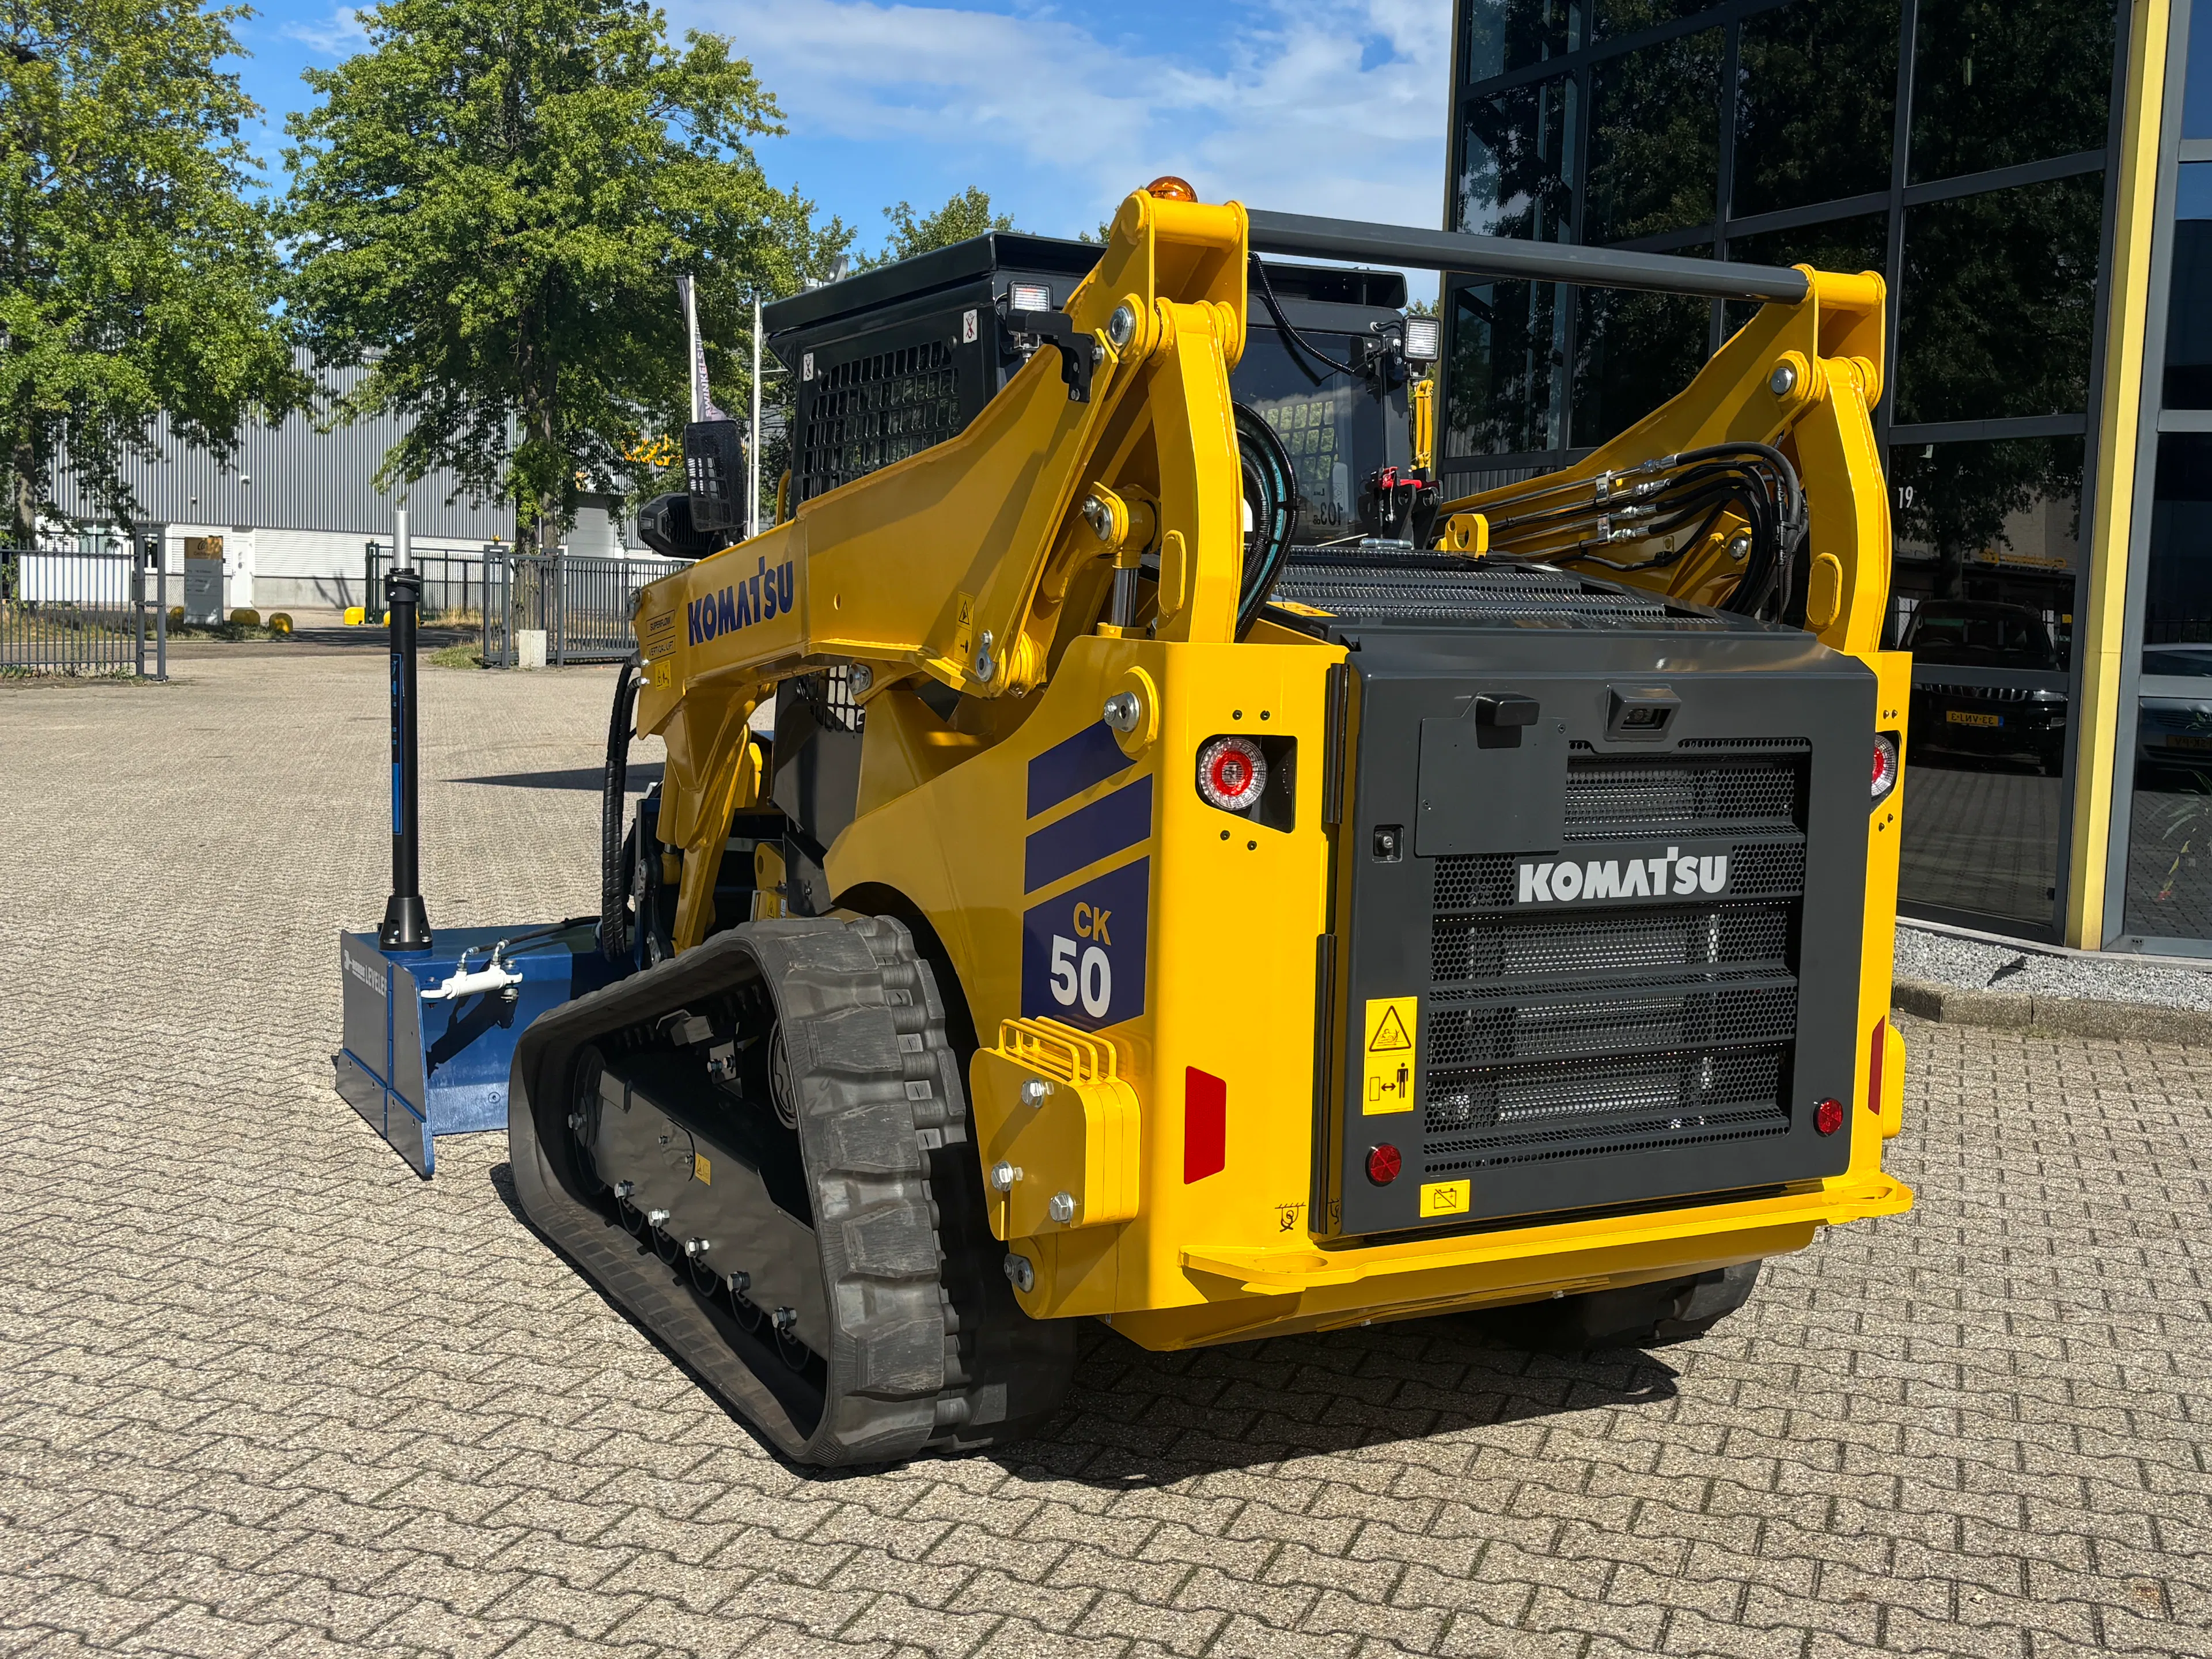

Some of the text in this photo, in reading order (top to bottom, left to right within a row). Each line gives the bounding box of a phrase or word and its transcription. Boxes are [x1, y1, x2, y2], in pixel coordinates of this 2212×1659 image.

[1899, 486, 1913, 509] 19
[688, 556, 793, 646] KOMATSU
[1518, 847, 1727, 902] KOMATSU
[1073, 902, 1112, 946] CK
[1050, 935, 1111, 1018] 50
